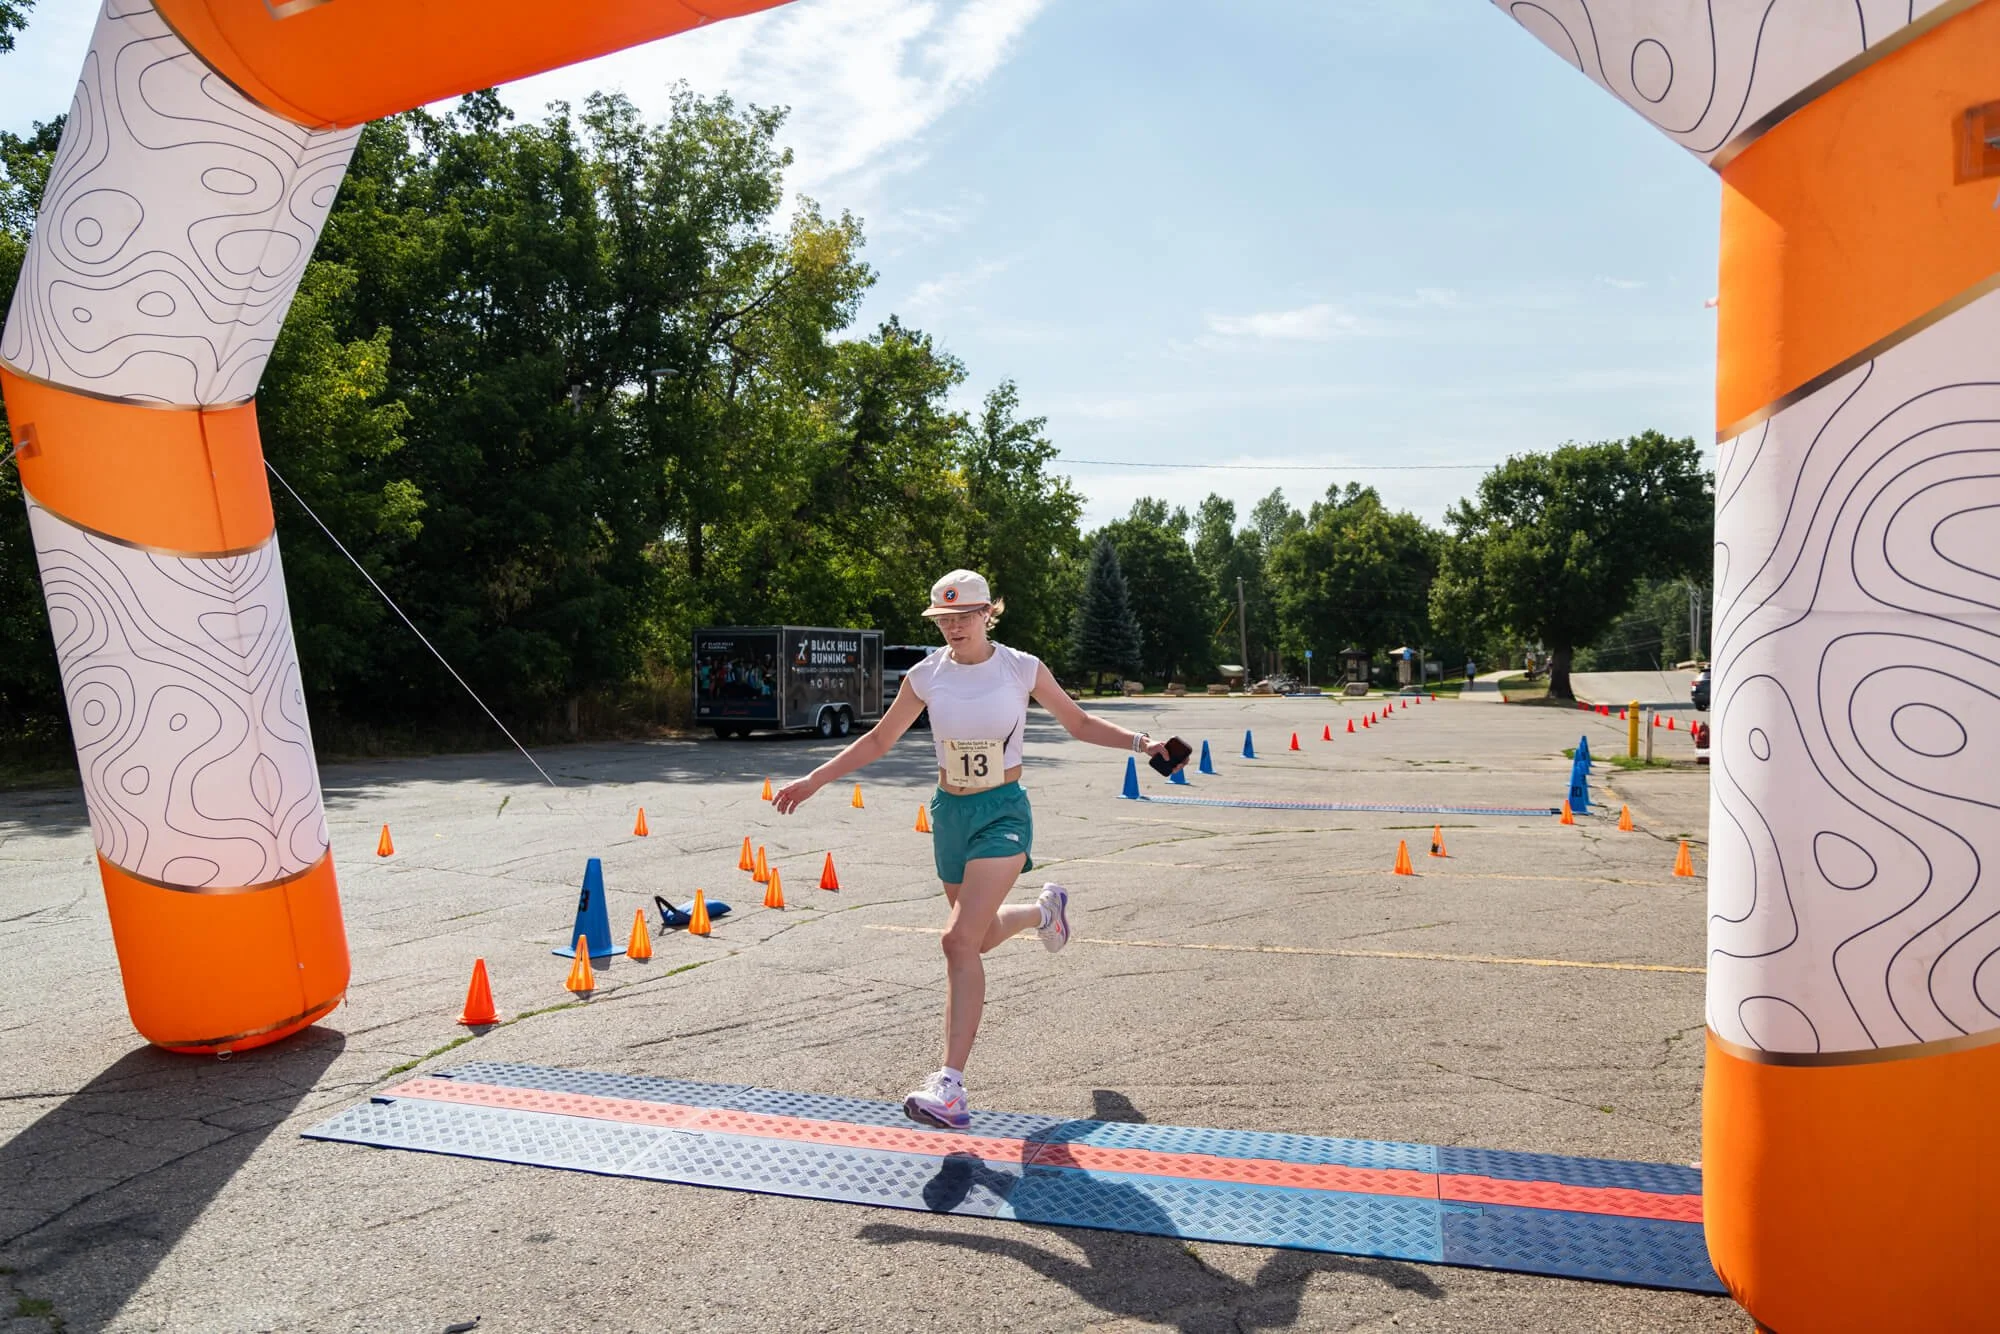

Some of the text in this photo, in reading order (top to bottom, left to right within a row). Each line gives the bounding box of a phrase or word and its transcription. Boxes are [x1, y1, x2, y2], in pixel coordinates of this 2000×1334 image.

[811, 639, 857, 652] BLACK HILLS
[811, 652, 846, 664] RUNNING
[960, 753, 989, 777] 13
